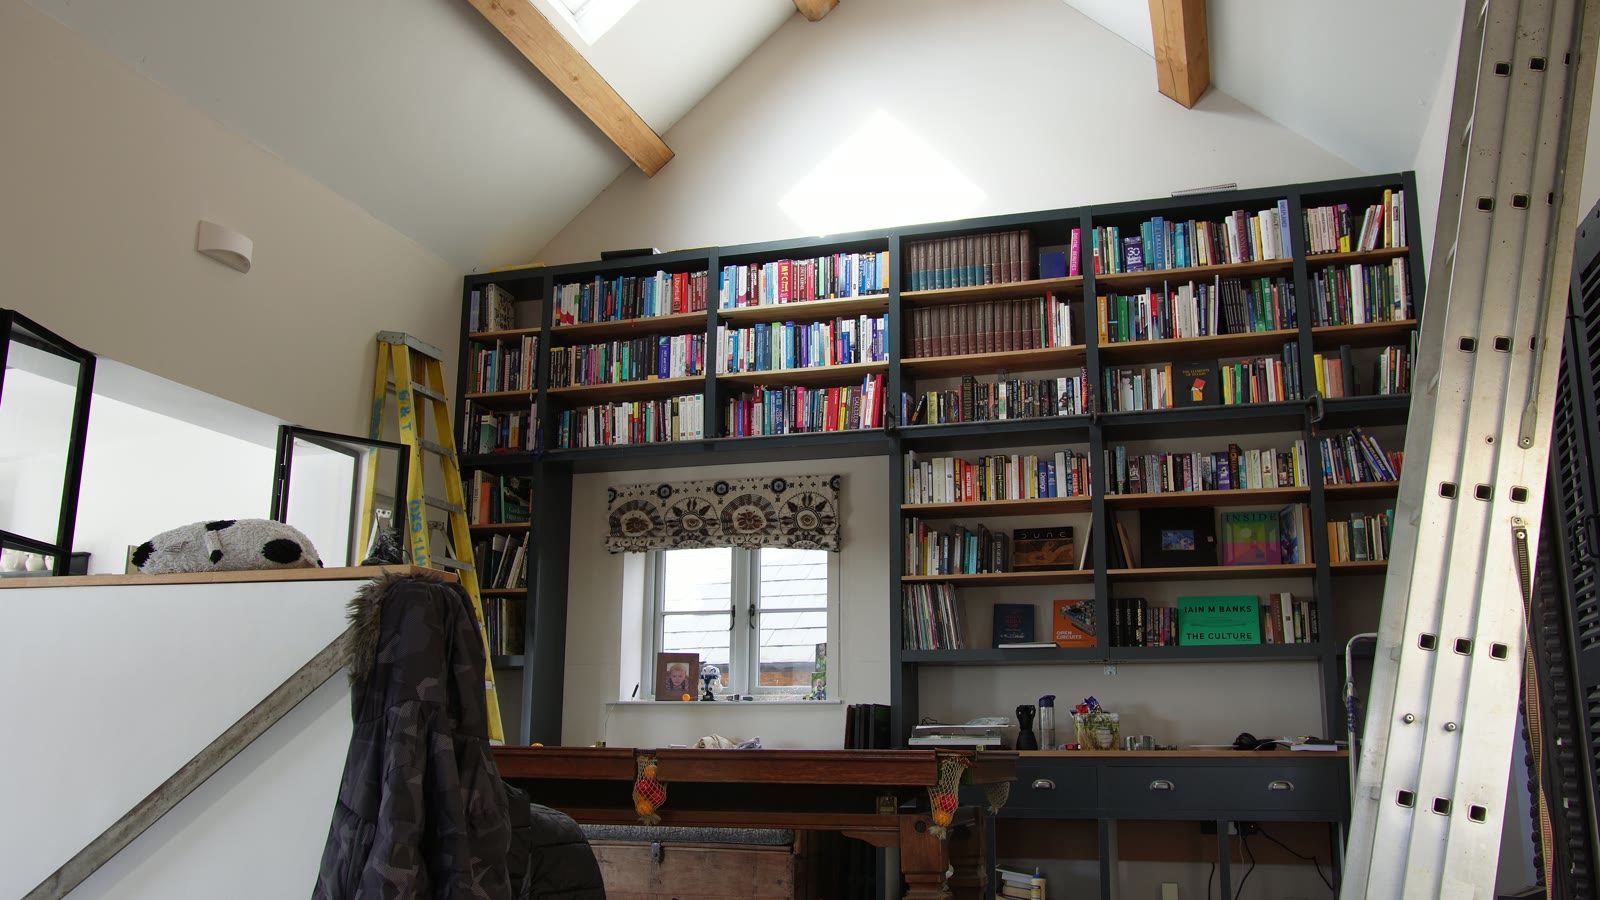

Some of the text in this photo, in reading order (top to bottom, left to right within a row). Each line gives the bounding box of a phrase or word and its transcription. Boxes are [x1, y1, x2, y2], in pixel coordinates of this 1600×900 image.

[1225, 513, 1278, 521] INSIDE
[1186, 632, 1253, 640] THE CULTURE
